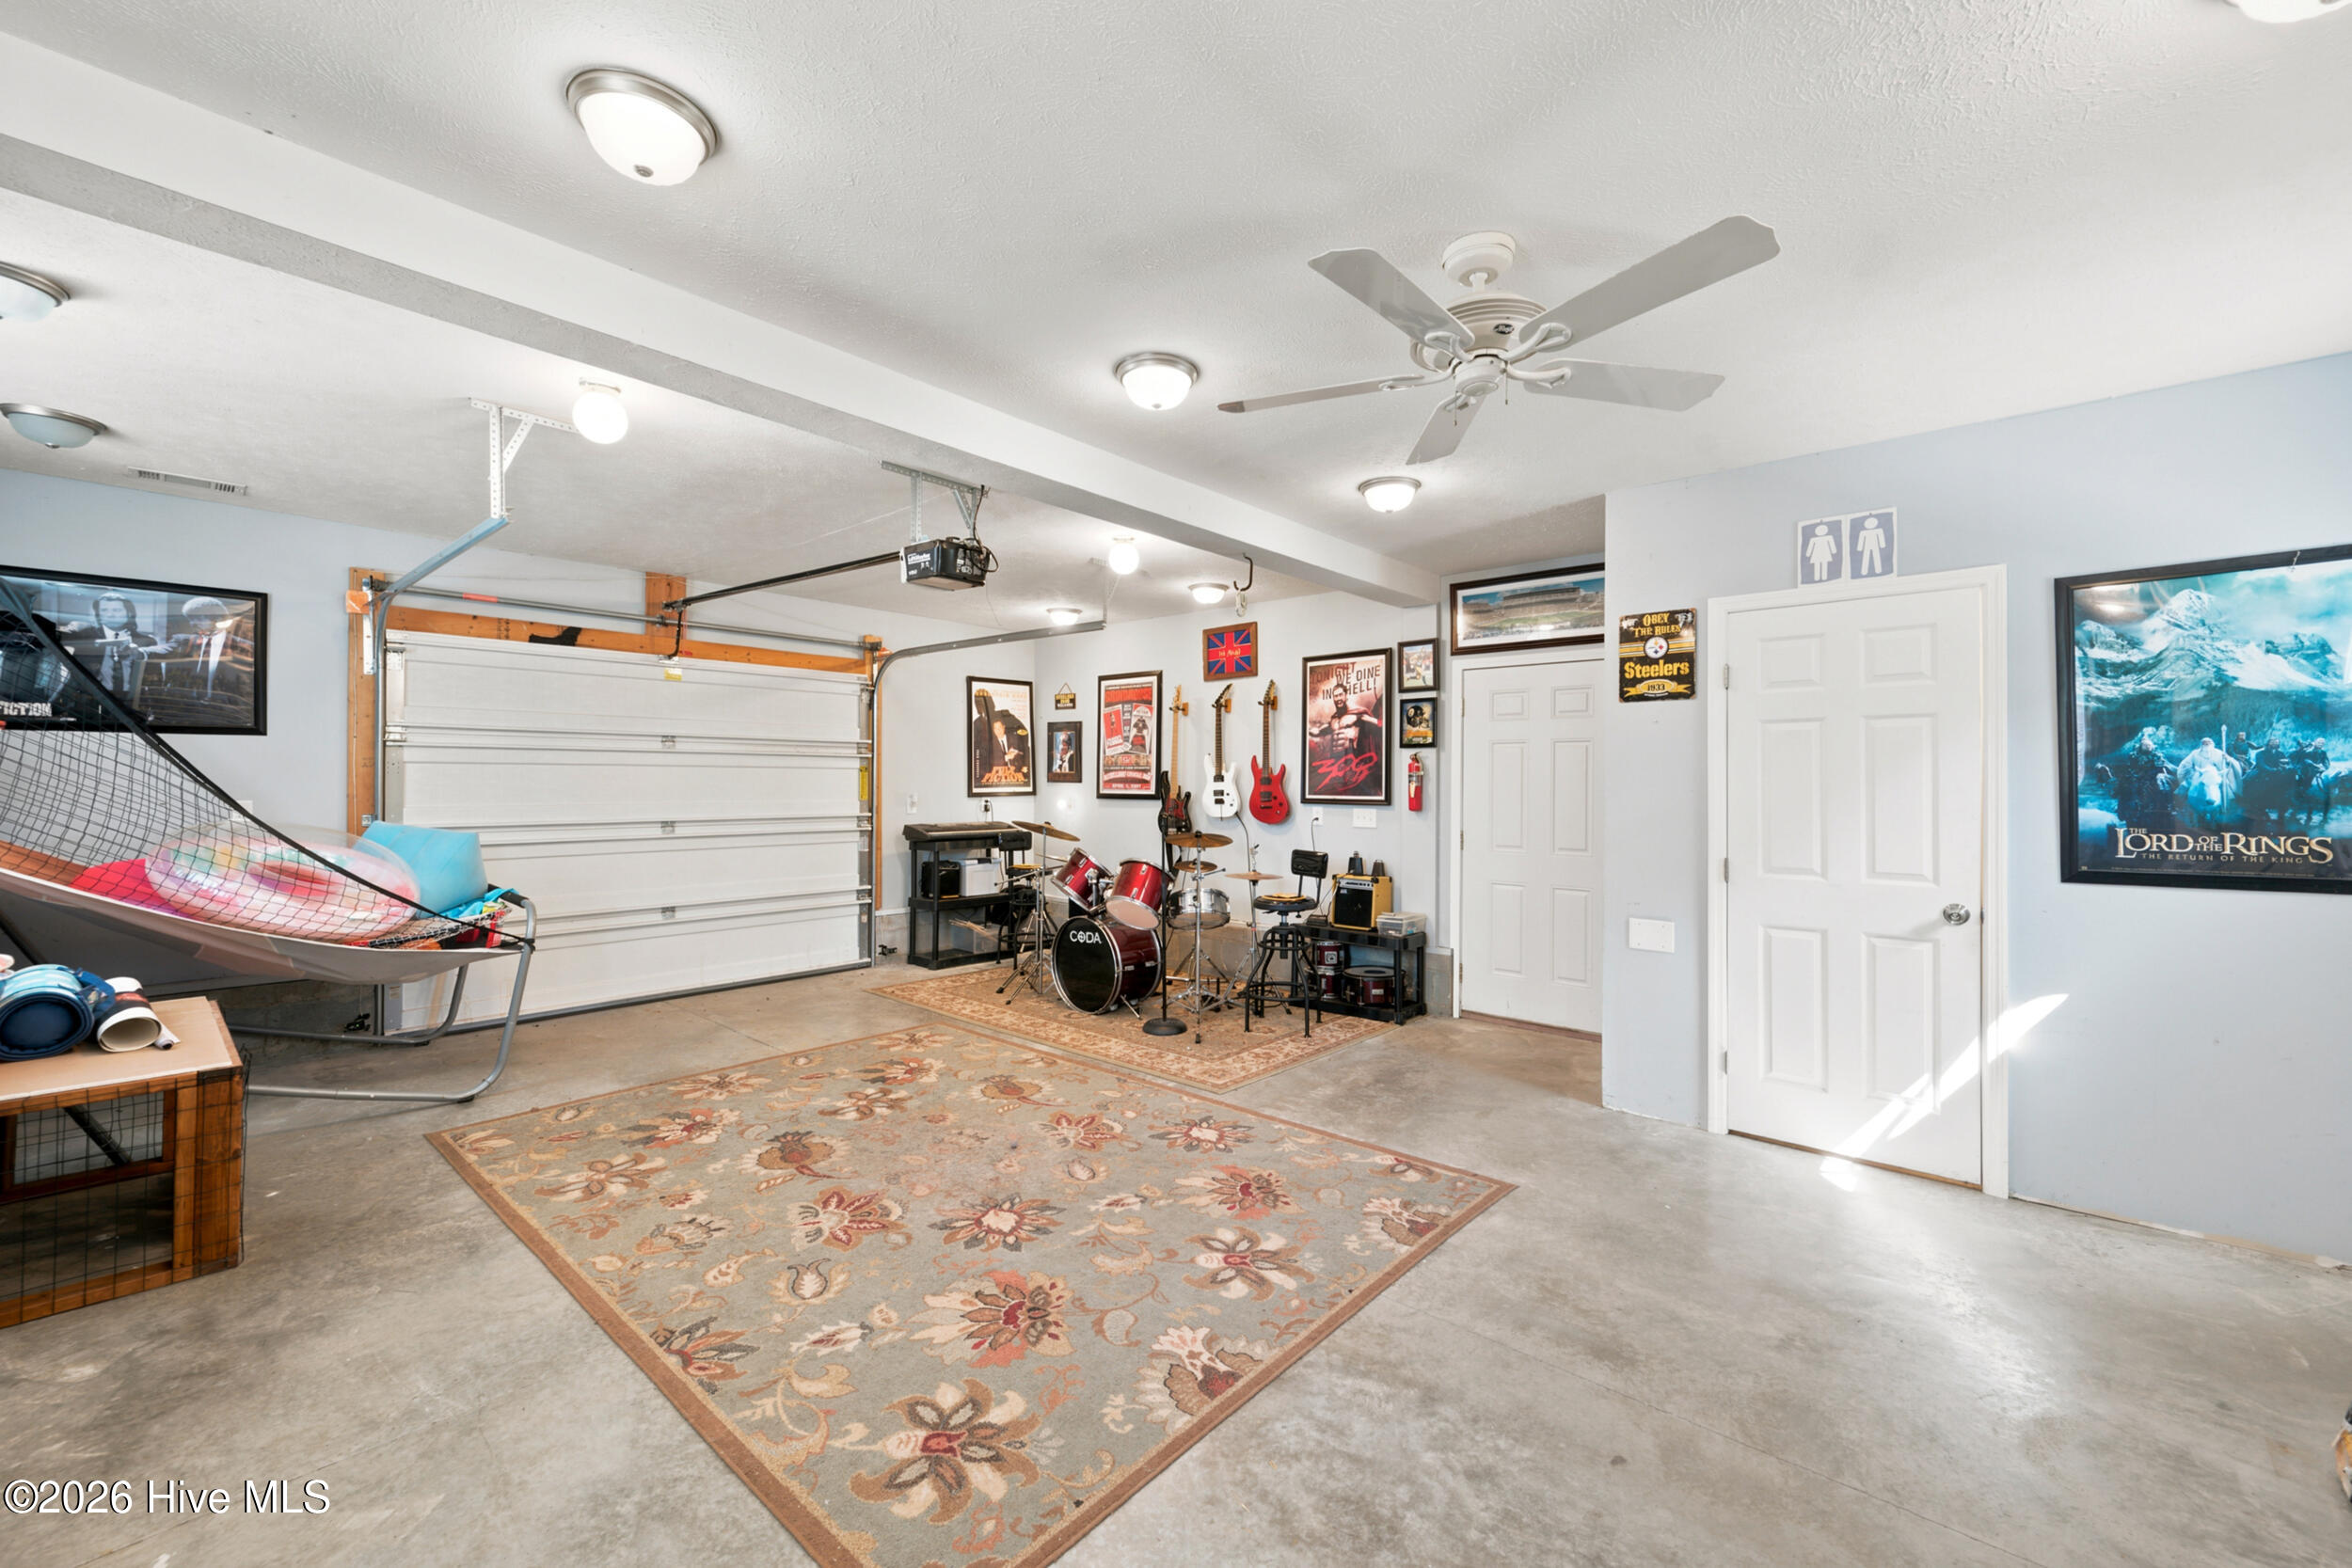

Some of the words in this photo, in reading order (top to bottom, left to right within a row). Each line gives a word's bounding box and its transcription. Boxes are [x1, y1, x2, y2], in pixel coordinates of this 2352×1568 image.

[1643, 613, 1670, 626] OBEY
[1629, 626, 1653, 638] THE
[1654, 625, 1681, 636] RULES
[1356, 665, 1380, 682] DINE
[1624, 659, 1690, 679] Steelers
[1322, 688, 1332, 700] IN
[1311, 752, 1378, 791] 300
[2115, 828, 2194, 858] LORD
[2199, 836, 2218, 845] OF
[2220, 832, 2334, 863] RINGS
[1070, 930, 1102, 943] CODA
